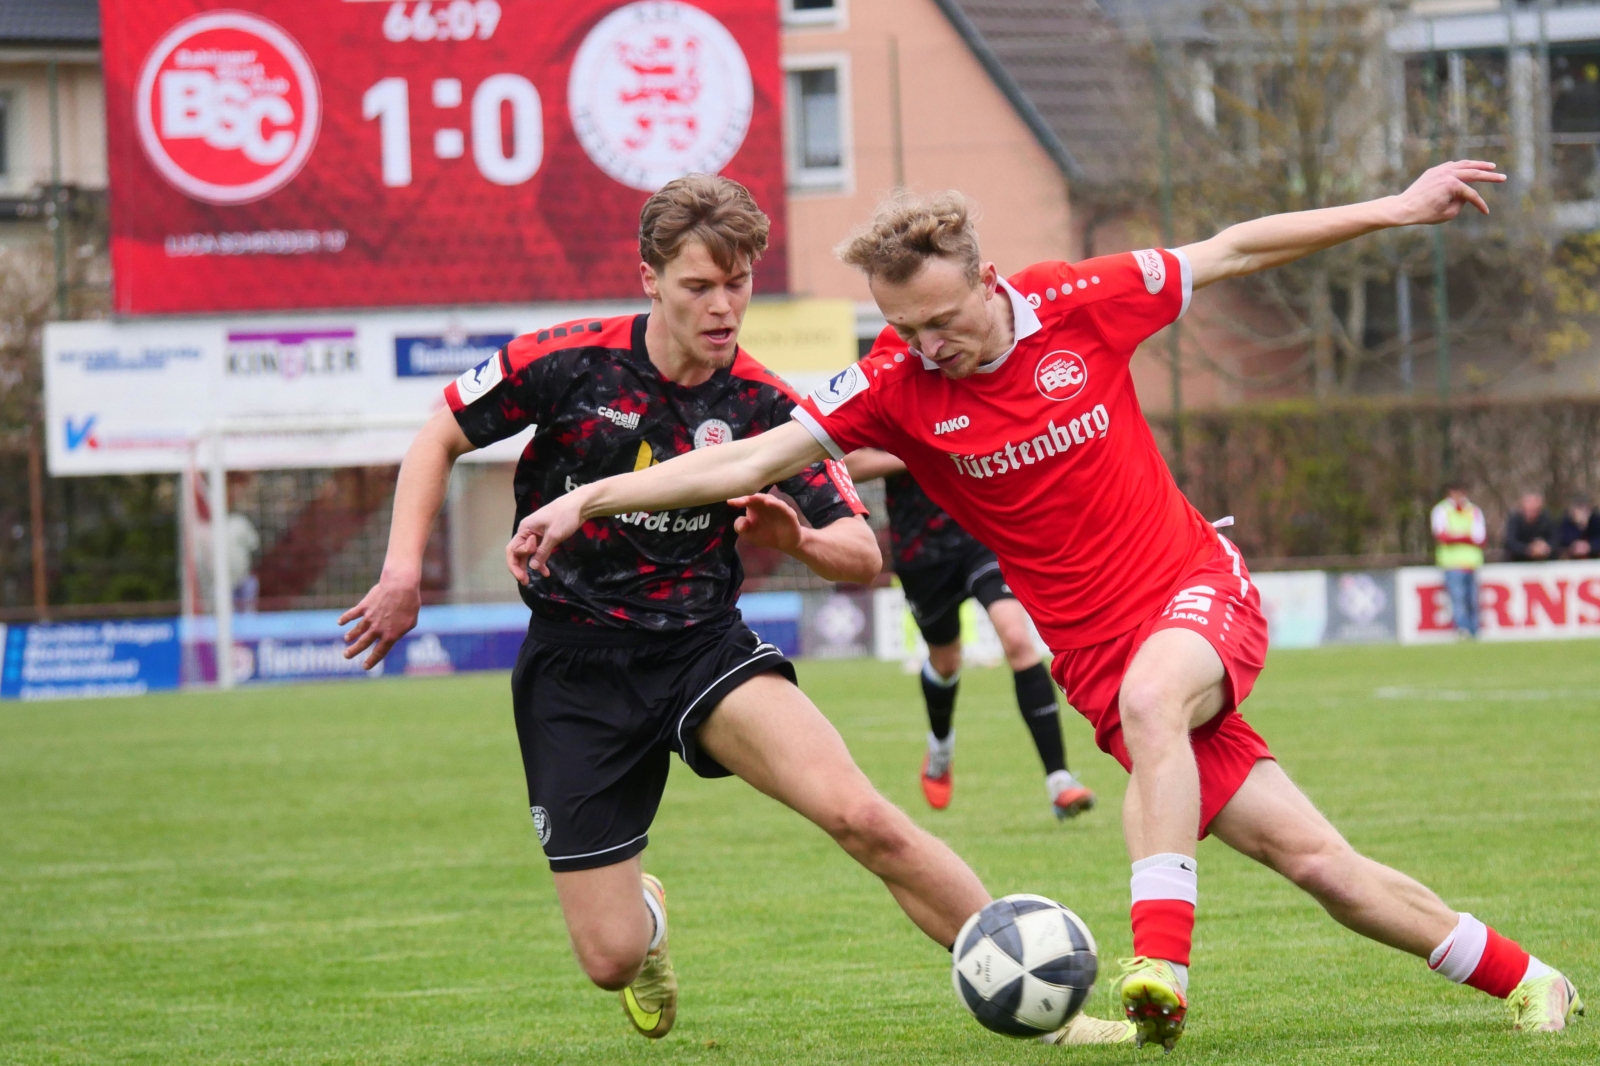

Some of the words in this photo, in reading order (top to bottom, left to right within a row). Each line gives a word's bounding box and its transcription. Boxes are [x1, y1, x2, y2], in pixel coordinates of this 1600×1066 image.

[382, 0, 502, 42] 66:09
[159, 69, 295, 165] BSC
[1039, 365, 1084, 393] BSC
[597, 406, 641, 427] capelli
[933, 415, 970, 435] JAKO
[672, 513, 711, 532] bau
[1168, 611, 1209, 626] JAKO
